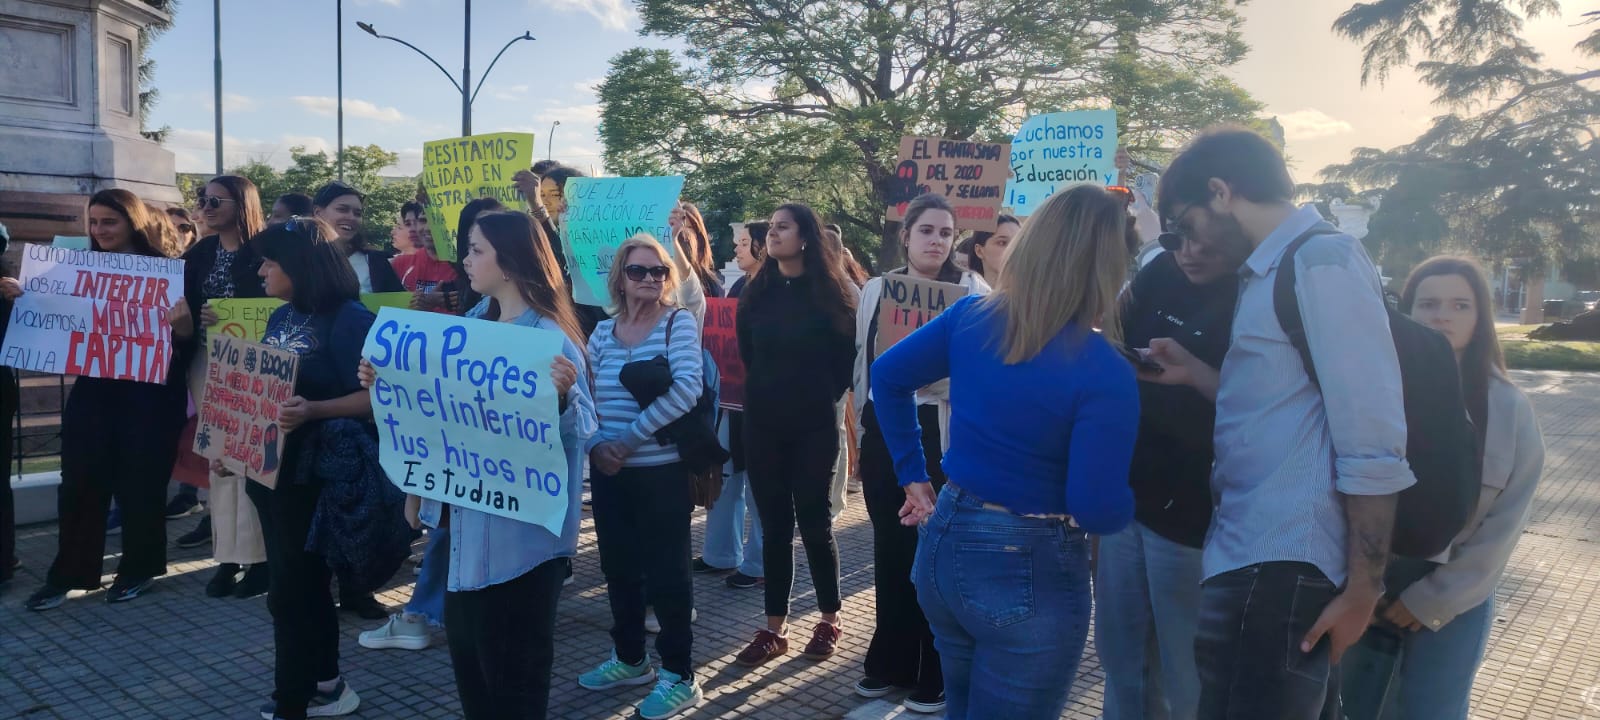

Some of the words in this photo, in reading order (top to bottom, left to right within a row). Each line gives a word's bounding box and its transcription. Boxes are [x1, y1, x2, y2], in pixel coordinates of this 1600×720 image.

[912, 139, 931, 160] EL
[938, 140, 1001, 161] FANTASMA
[1010, 149, 1034, 167] por
[1043, 141, 1103, 159] nuestra
[482, 163, 502, 181] EN
[926, 163, 948, 180] DEL
[954, 164, 983, 180] 2020
[1013, 164, 1098, 183] Educación
[1104, 173, 1112, 184] y
[567, 182, 601, 200] QUE
[606, 182, 626, 200] LA
[945, 183, 954, 196] Y
[1010, 189, 1026, 205] la
[563, 200, 634, 223] EDUCACIÓN
[638, 203, 658, 221] DE
[565, 226, 617, 246] MAÑANA
[29, 245, 66, 265] COMO
[68, 248, 94, 268] DIJO
[97, 250, 134, 271] PABLO
[24, 276, 49, 294] LOS
[50, 279, 69, 296] DEL
[70, 270, 171, 308] INTERIOR
[884, 278, 907, 304] NO
[911, 283, 922, 308] A
[927, 287, 945, 311] LA
[15, 306, 79, 332] VOLVEMOS
[79, 317, 87, 333] A
[4, 345, 31, 370] EN
[36, 351, 57, 373] LA
[211, 339, 240, 366] 31/10
[370, 320, 428, 375] Sin
[441, 325, 538, 400] Profes
[209, 363, 223, 384] EL
[375, 377, 412, 411] en
[417, 378, 448, 422] el
[449, 389, 553, 450] interior,
[240, 421, 250, 445] Y
[383, 413, 429, 459] tus
[441, 429, 516, 484] hijos
[525, 465, 561, 497] no
